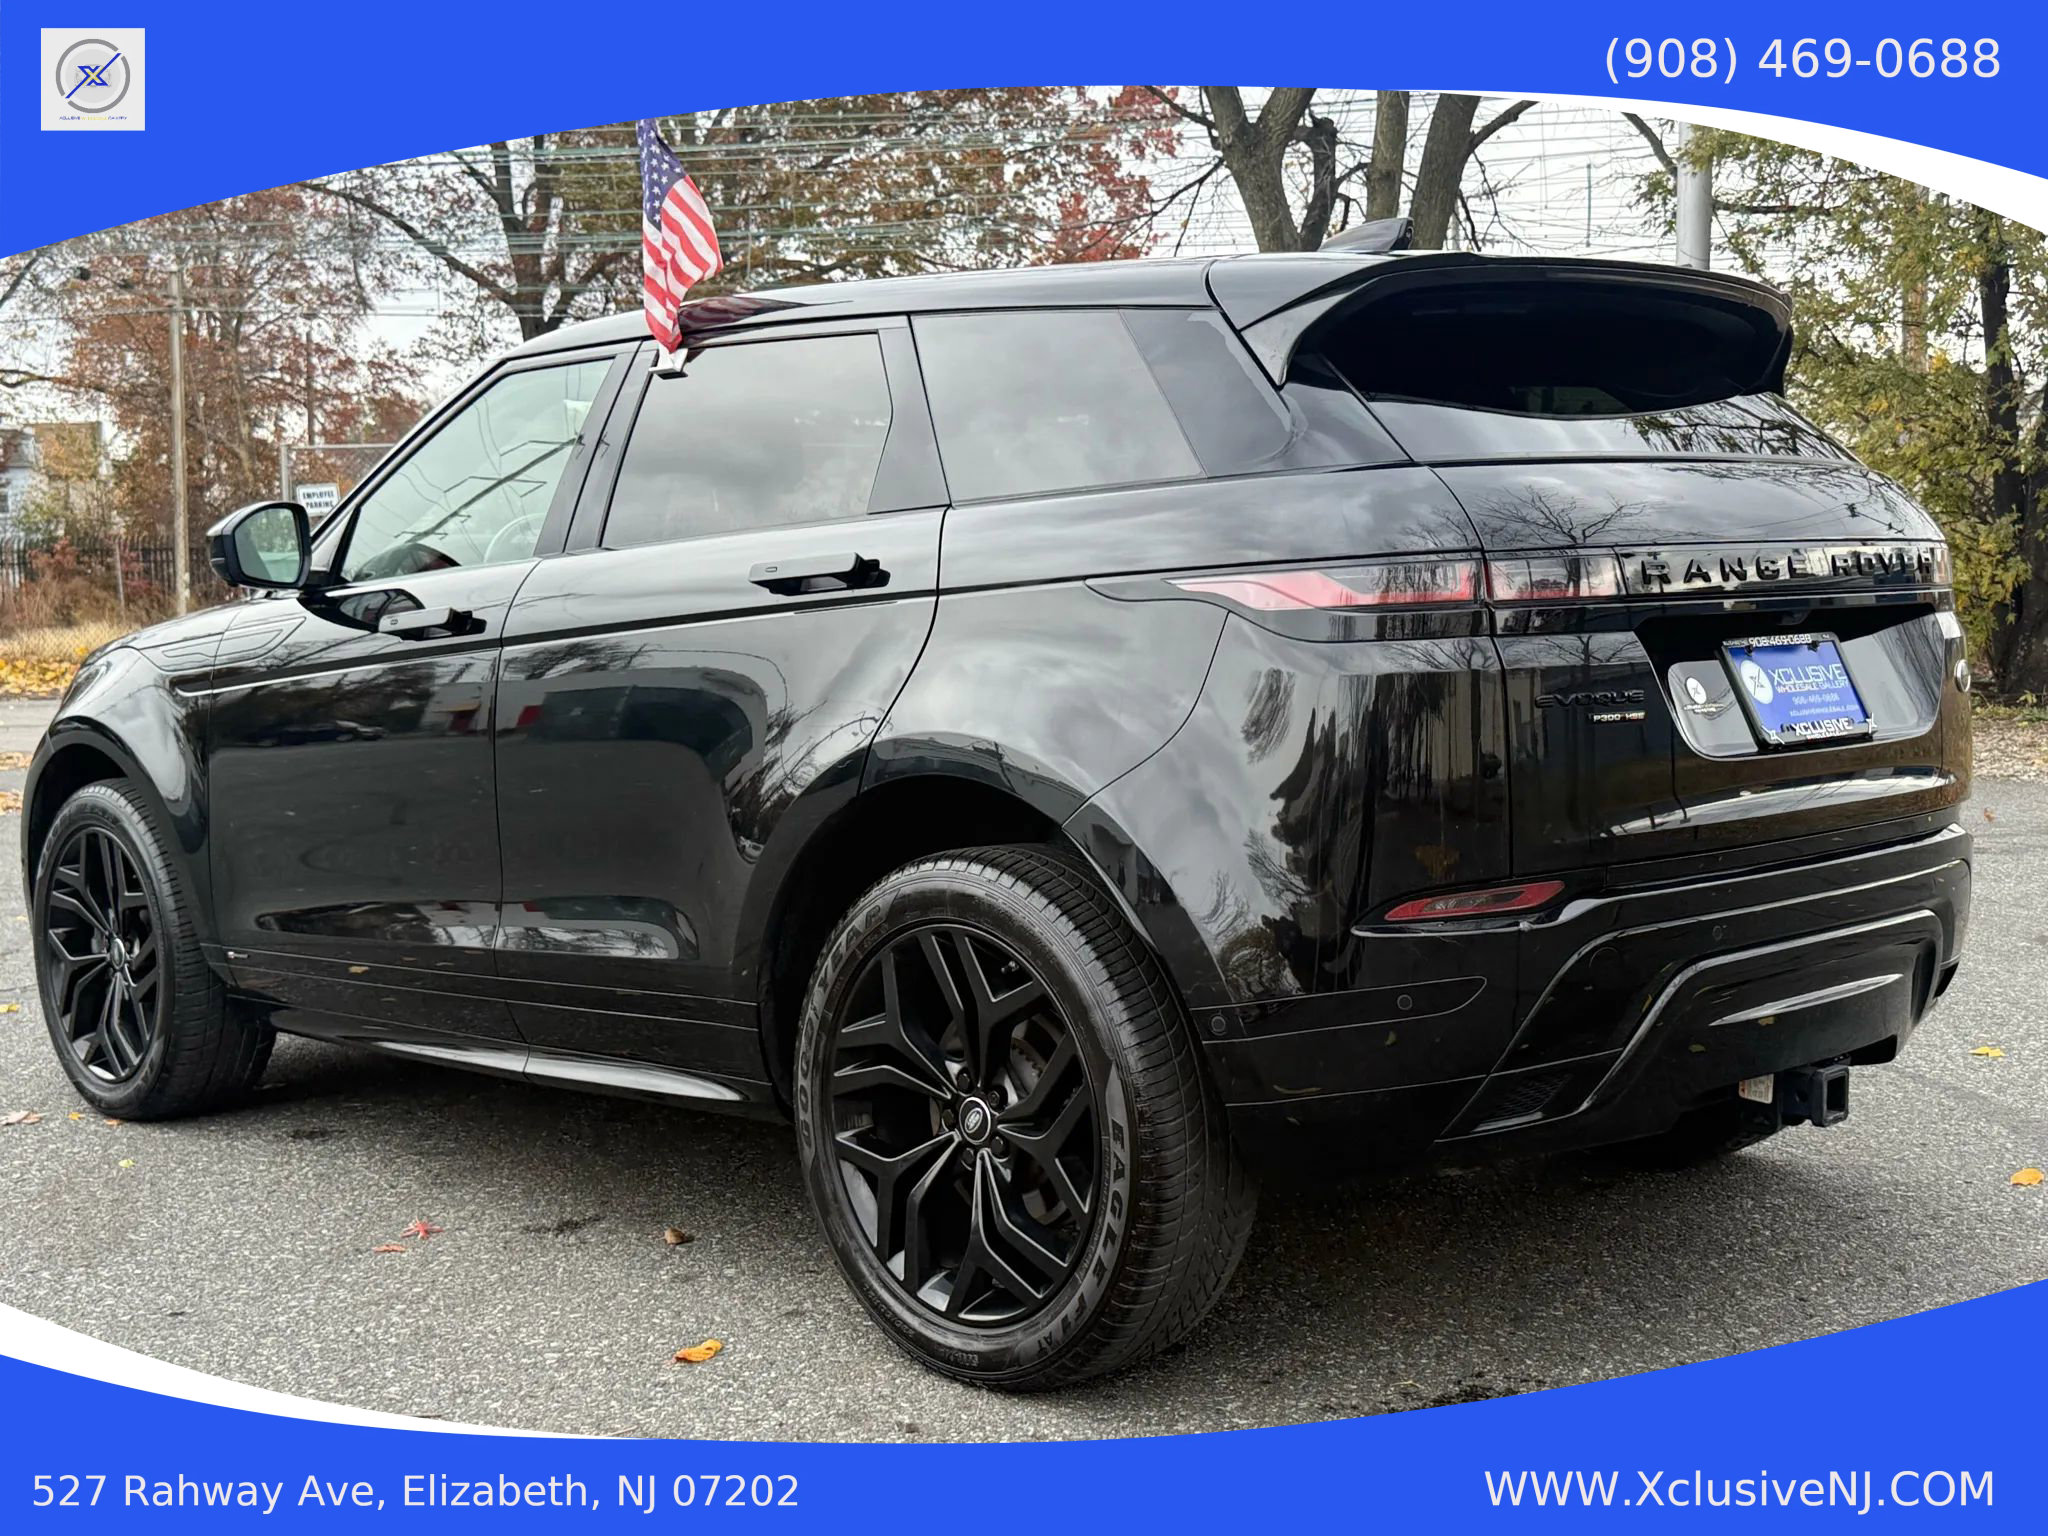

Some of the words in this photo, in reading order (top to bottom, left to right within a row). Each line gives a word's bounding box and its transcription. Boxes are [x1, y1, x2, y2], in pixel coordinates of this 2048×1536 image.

[303, 490, 334, 499] EMPLOYEE
[1641, 553, 1812, 585] RANGE
[1768, 663, 1848, 686] XCLUSIVE
[1775, 682, 1819, 694] WHOLESALE
[1819, 680, 1849, 690] GALLERY
[1534, 689, 1645, 708] EVOQUE
[1593, 713, 1621, 722] P300
[1625, 711, 1646, 720] HSE
[1791, 717, 1854, 736] XCLUSIVE
[1092, 1117, 1129, 1287] EAGLE
